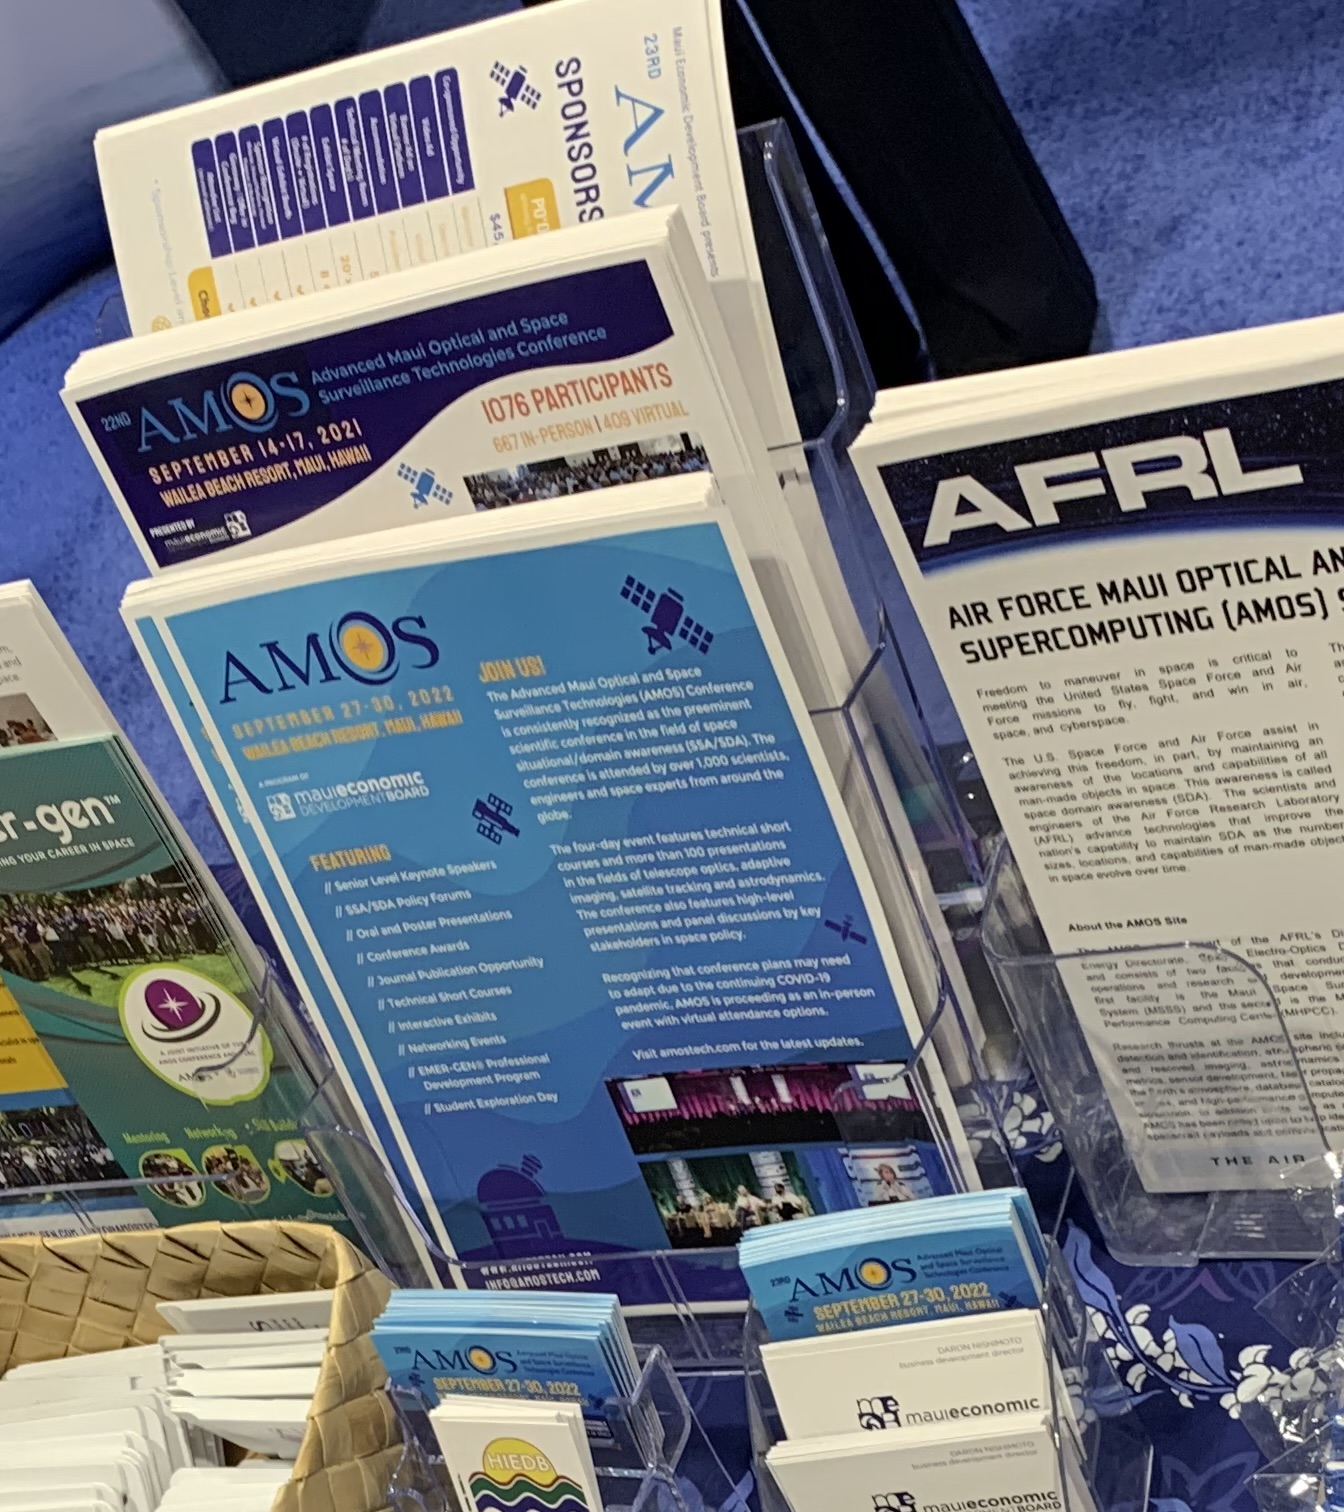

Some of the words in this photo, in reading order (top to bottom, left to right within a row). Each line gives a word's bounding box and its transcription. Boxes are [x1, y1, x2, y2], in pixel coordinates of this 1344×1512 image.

[643, 32, 662, 80] 23RD
[671, 25, 685, 56] Maui
[674, 57, 690, 113] Economic
[682, 114, 704, 192] Development
[695, 193, 711, 227] Board
[699, 229, 719, 281] presents
[309, 352, 386, 385] Advanced
[386, 341, 426, 366] Maui
[427, 327, 485, 356] Optical
[486, 319, 519, 341] and
[519, 312, 568, 335] Space
[317, 371, 411, 404] Surveillance
[410, 346, 515, 381] Technologies
[516, 326, 607, 357] Conference
[137, 370, 311, 453] AMOS
[480, 391, 530, 424] 1076
[529, 361, 673, 414] PARTICIPANTS
[100, 410, 131, 431] 22ND
[491, 432, 520, 453] 667
[518, 417, 595, 448] IN-PERSON
[601, 409, 632, 430] 409
[629, 399, 690, 425] VIRTUAL
[148, 443, 254, 485] SEPTEMBER
[316, 417, 362, 444] 2021
[158, 482, 207, 508] WAILEA
[203, 472, 246, 497] BEACH
[242, 460, 297, 488] RESORT,
[292, 453, 331, 476] MAUI,
[326, 442, 372, 469] HAWAII
[923, 428, 1304, 548] AFRL
[148, 520, 187, 538] PRESENTED
[184, 517, 196, 529] BY
[947, 600, 993, 629] AIR
[996, 584, 1091, 621] FORCE
[1095, 572, 1168, 606] MAUI
[1175, 554, 1302, 594] OPTICAL
[959, 605, 1214, 664] SUPERCOMPUTING
[1220, 586, 1329, 631] (AMOS)
[219, 610, 441, 704] AMOS
[476, 660, 516, 682] JOIN
[514, 655, 545, 677] US!
[231, 704, 335, 740] SEPTEMBER
[340, 695, 402, 719] 27-30,
[407, 686, 454, 707] 2022
[293, 770, 424, 806] mauieconomic
[16, 850, 47, 863] YOUR
[46, 843, 89, 859] CAREER
[87, 841, 101, 852] IN
[100, 836, 135, 851] SPACE
[309, 845, 390, 869] FEATURING
[333, 877, 369, 892] Senior
[369, 871, 400, 886] Level
[399, 866, 446, 882] Keynote
[445, 860, 497, 876] Speakers
[344, 898, 396, 915] SSA/SDA
[395, 894, 429, 908] Policy
[429, 888, 472, 903] Forums
[376, 970, 417, 986] Journal
[416, 964, 478, 980] Publication
[477, 955, 544, 974] Opportunity
[631, 1047, 658, 1060] Visit
[659, 1042, 741, 1058] amostech.com
[740, 1039, 758, 1051] for
[758, 1039, 779, 1050] the
[779, 1037, 813, 1049] latest
[813, 1035, 864, 1049] updates.
[121, 1132, 168, 1144] Mentoring
[485, 1269, 601, 1290] INFO@AMOSTECH.COM
[789, 1256, 918, 1303] AMOS
[812, 1292, 900, 1320] SEPTEMBER
[899, 1286, 950, 1306] 27-30,
[948, 1281, 991, 1300] 2022
[411, 1343, 519, 1376] AMOS
[905, 1397, 1040, 1424] mauieconomic
[486, 1451, 552, 1472] HIEDB
